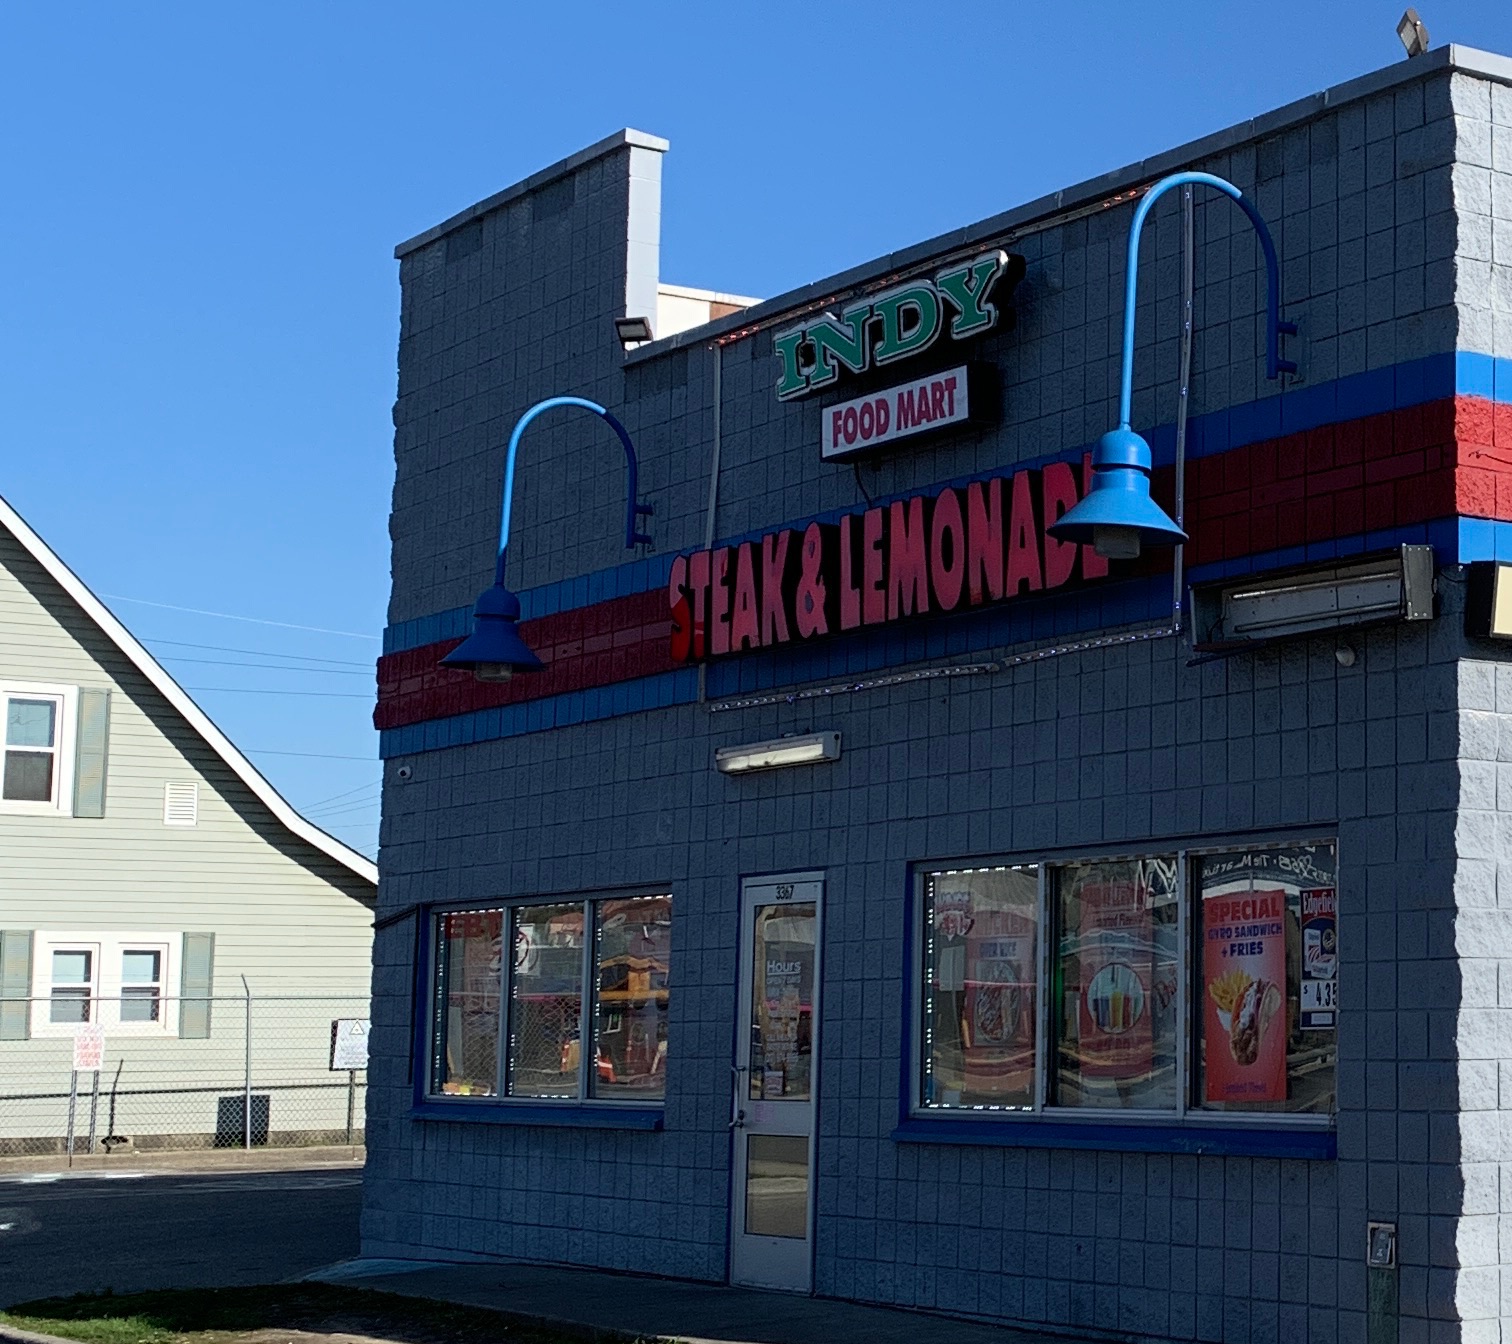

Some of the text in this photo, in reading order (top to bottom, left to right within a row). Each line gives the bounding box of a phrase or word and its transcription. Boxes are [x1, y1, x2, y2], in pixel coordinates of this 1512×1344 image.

[772, 250, 1007, 401] INDY
[831, 375, 958, 448] FOOD MART
[669, 529, 793, 662] STEAK
[796, 522, 827, 638] &
[1209, 897, 1281, 923] SPECIAL
[1302, 890, 1336, 917] Edgefiel
[1234, 923, 1283, 939] SANDWICH
[1230, 941, 1264, 957] FRIES
[767, 959, 802, 973] Hours
